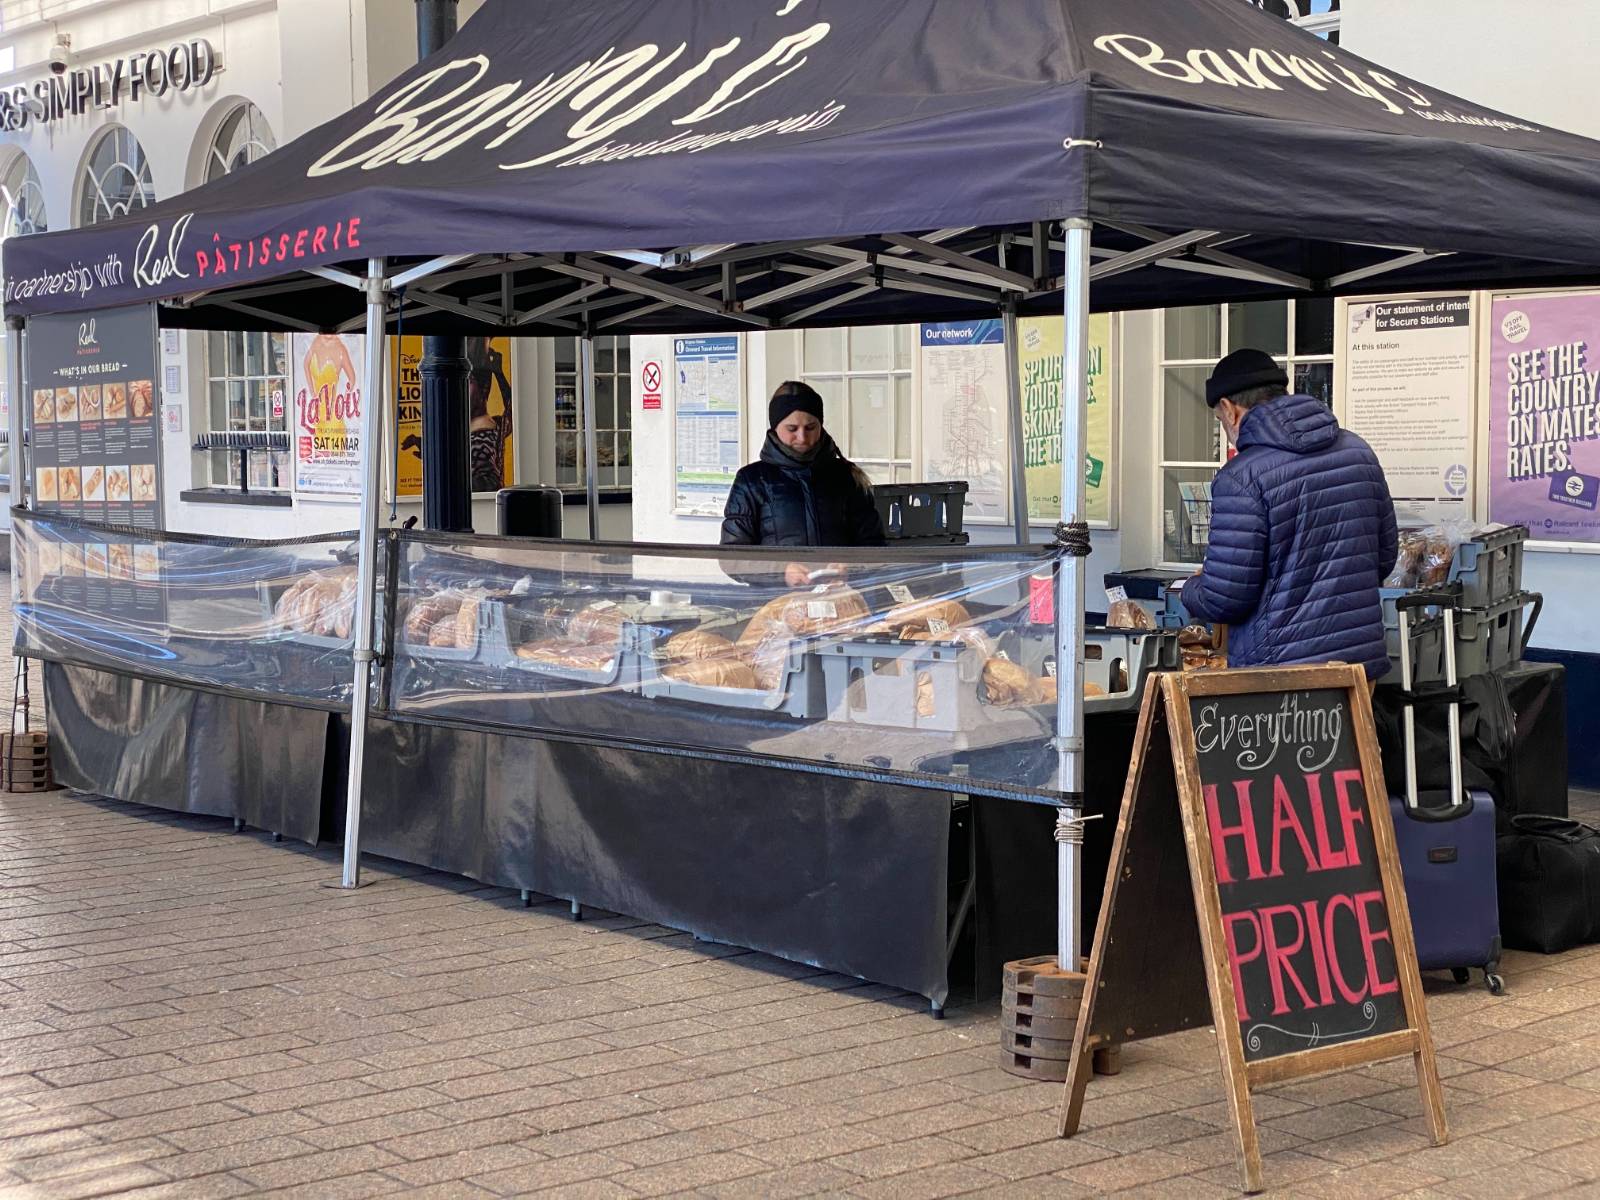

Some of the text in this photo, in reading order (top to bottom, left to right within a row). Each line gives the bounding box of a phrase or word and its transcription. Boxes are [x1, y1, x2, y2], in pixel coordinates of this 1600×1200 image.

[31, 58, 124, 124] SIMPLY
[128, 37, 214, 102] FOOD
[14, 261, 93, 303] partnership
[94, 253, 124, 287] with
[133, 212, 194, 288] Real
[196, 218, 361, 278] PÂTISSERIE
[1376, 301, 1470, 315] Our statement of intent
[1376, 315, 1454, 327] for Secure Stations
[79, 318, 97, 346] Real
[926, 327, 973, 338] Our network
[59, 362, 120, 376] WHAT'S IN OUR BREAD
[402, 368, 420, 382] TH
[1507, 348, 1543, 385] SEE
[1547, 341, 1586, 378] THE
[297, 382, 361, 435] La Voix
[399, 387, 421, 401] LIO
[1024, 380, 1057, 413] YOUR
[1507, 370, 1600, 417] COUNTRY
[398, 406, 421, 420] KIN
[1507, 412, 1535, 447] ON
[314, 437, 330, 450] SAT
[331, 438, 339, 450] 14
[341, 438, 359, 451] MAR
[1507, 440, 1573, 478] RATES.
[1195, 693, 1342, 772] Everything
[1203, 768, 1365, 884] HALF
[1221, 890, 1398, 1022] PRICE
